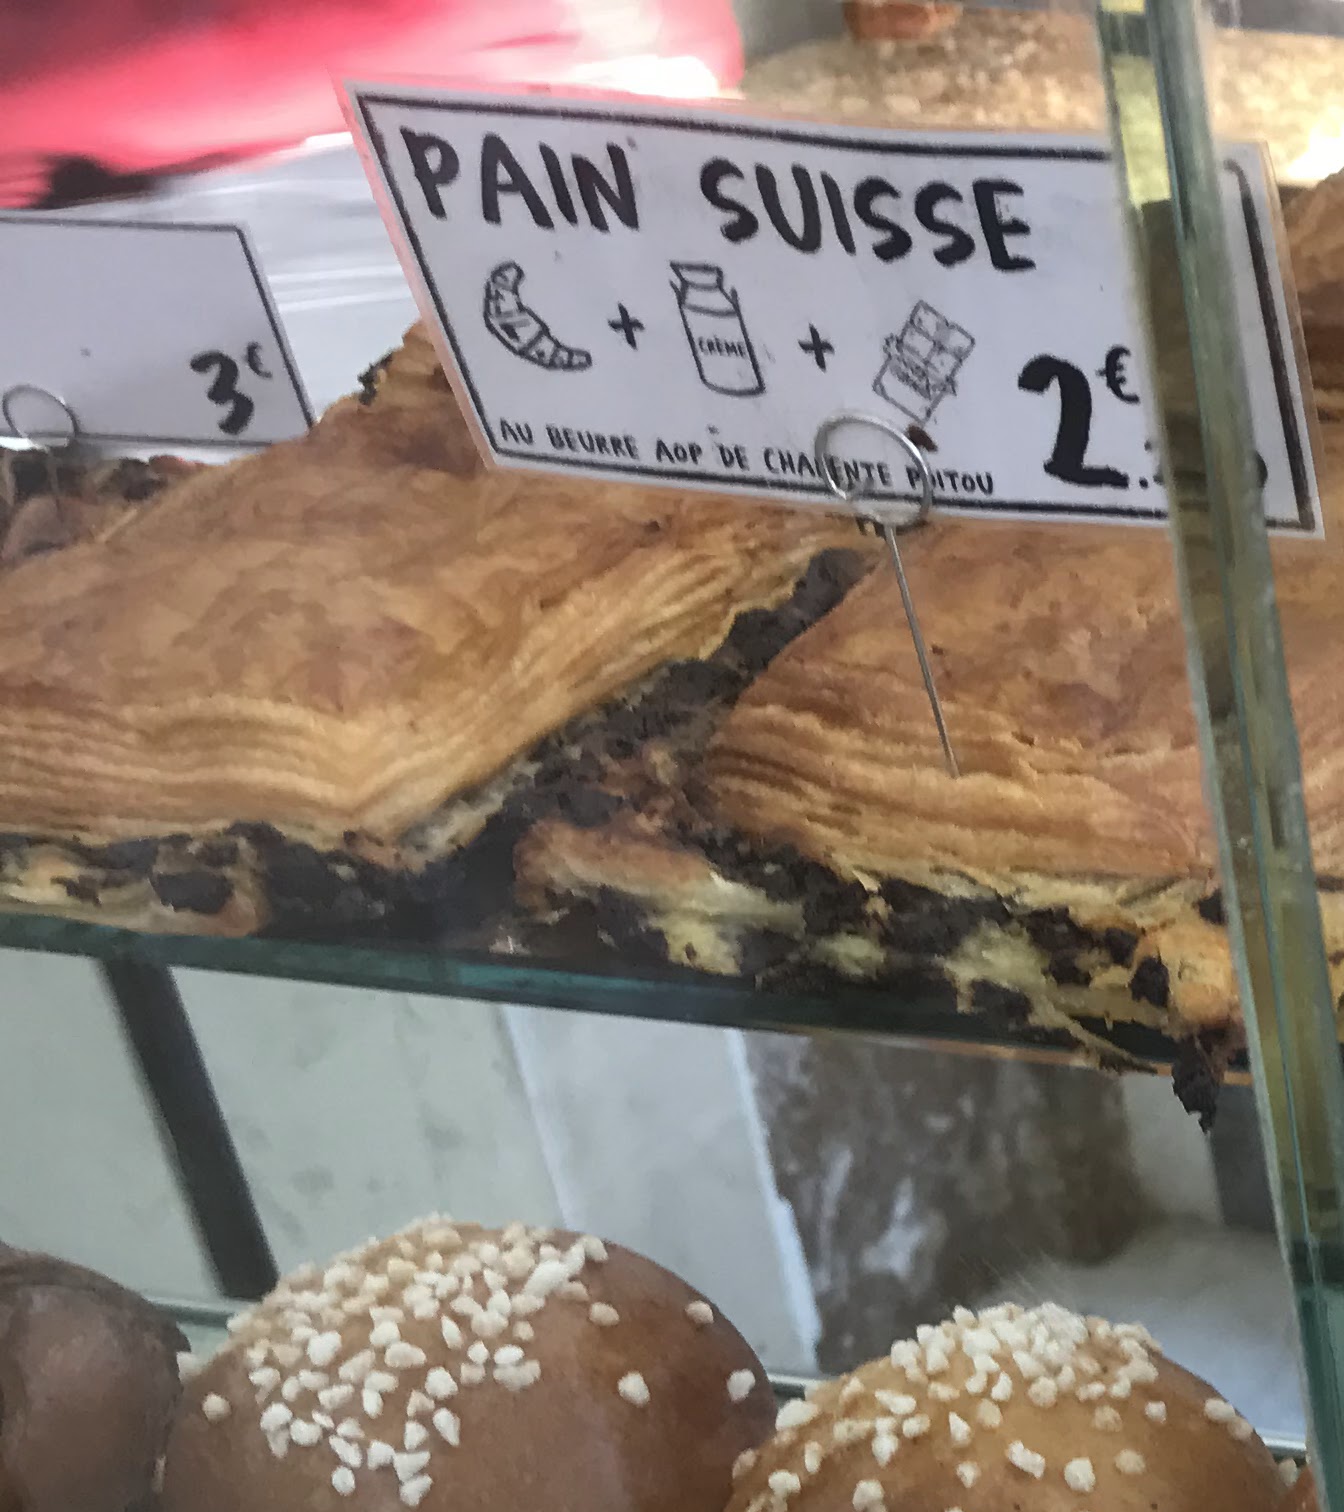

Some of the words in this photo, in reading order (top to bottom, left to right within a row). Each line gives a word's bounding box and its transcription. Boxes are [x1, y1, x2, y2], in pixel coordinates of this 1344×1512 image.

[400, 126, 639, 232] PAIN
[699, 155, 1037, 272] SUISSE
[500, 416, 533, 446] AU
[545, 422, 638, 461] BEURRE
[654, 437, 703, 465] AOP
[719, 442, 748, 472] DE
